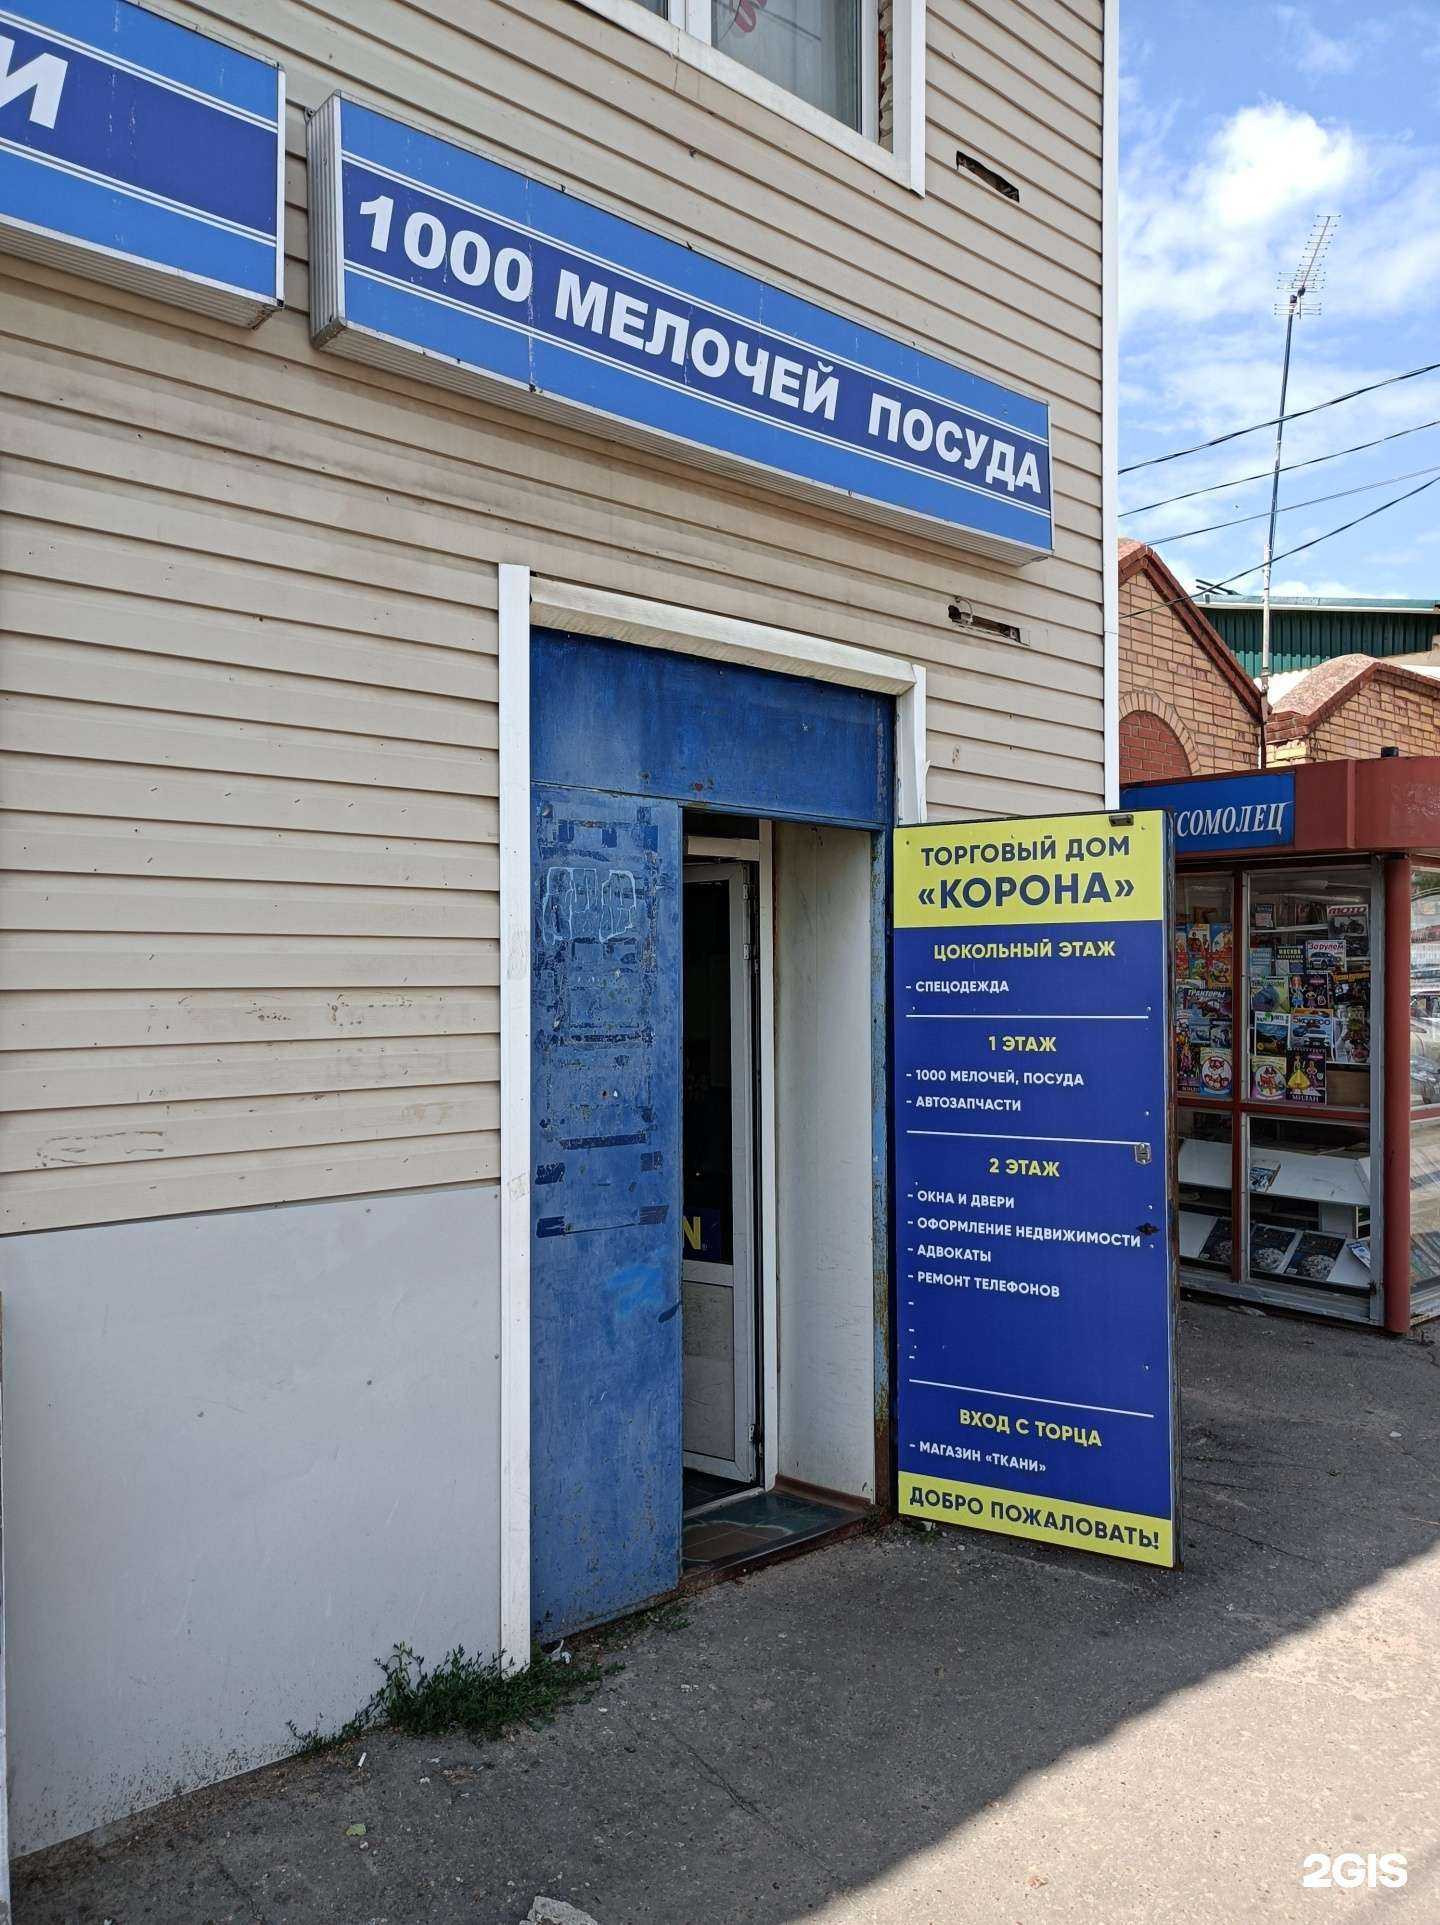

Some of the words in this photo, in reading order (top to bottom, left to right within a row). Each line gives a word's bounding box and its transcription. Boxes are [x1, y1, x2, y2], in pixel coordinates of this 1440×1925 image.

[359, 195, 533, 303] 1000
[555, 269, 839, 420] МЕЛОЧЕЙ
[868, 393, 1042, 492] ПОСУДА
[1174, 803, 1287, 837] СОМОЛЕЦ
[921, 836, 1056, 867] ТОРГОВЫЙ
[1065, 835, 1130, 862] ДОМ
[918, 872, 1135, 909] «КОРОНА»
[934, 939, 1052, 963] ЦОКОЛЬНЫЙ
[1059, 940, 1116, 957] ЭТАЖ
[915, 980, 1009, 994] СПЕЦОДЕЖДА
[989, 1036, 997, 1051] 1
[1002, 1036, 1057, 1052] ЭТАЖ
[916, 1069, 947, 1081] 1000
[950, 1069, 1019, 1085] МЕЛОЧЕЙ,
[1024, 1072, 1084, 1087] ПОСУДА
[916, 1096, 1021, 1111] АВТОЗАПЧАСТИ
[989, 1158, 999, 1173] 2
[1006, 1159, 1060, 1177] ЭТАЖ
[917, 1190, 954, 1204] ОКНА
[958, 1193, 967, 1205] И
[970, 1194, 1015, 1209] ДВЕРИ
[917, 1217, 1012, 1236] ОФОРМЛЕНИЕ
[1015, 1225, 1141, 1247] НЕДВИЖИМОСТИ
[917, 1245, 991, 1262] АДВОКАТЫ
[917, 1271, 970, 1288] РЕМОНТ
[974, 1277, 1060, 1298] ТЕЛЕФОНОВ
[959, 1408, 1010, 1435] ВХОД
[1016, 1418, 1030, 1434] С
[1035, 1421, 1102, 1447] ТОРЦА
[920, 1441, 981, 1462] МАГАЗИН
[985, 1453, 1046, 1473] «ТКАНИ»
[909, 1486, 983, 1515] ДОБРО
[991, 1501, 1159, 1549] ПОЖАЛОВАТЬ!
